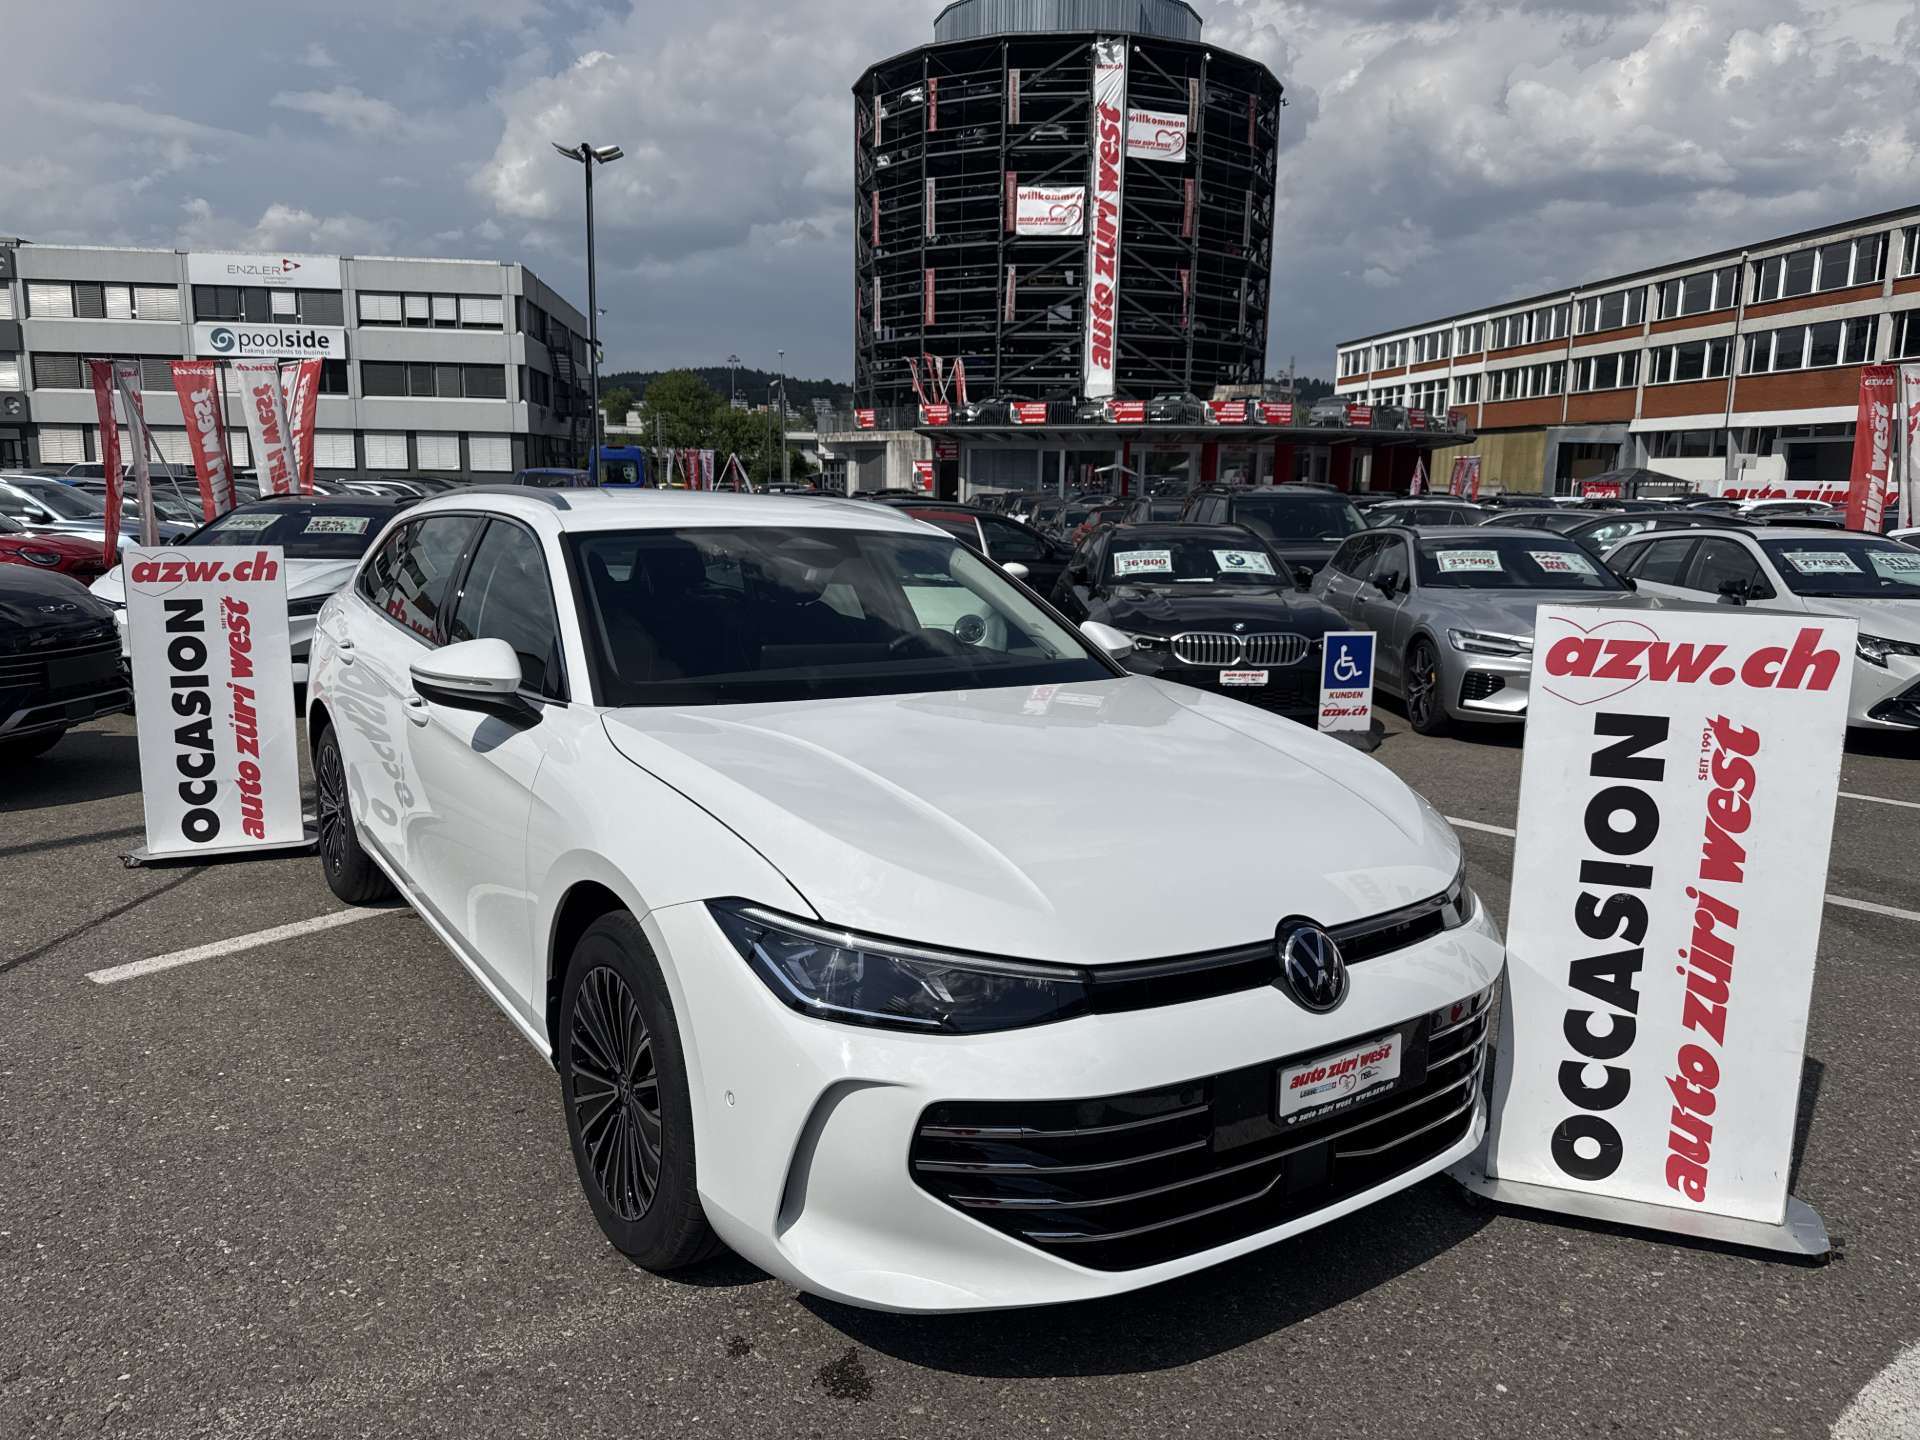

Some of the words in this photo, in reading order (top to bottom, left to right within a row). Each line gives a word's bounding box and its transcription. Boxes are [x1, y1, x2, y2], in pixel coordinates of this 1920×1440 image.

[1099, 101, 1121, 192] west
[1128, 113, 1186, 127] willkommen
[227, 264, 281, 276] ENZLER
[1092, 196, 1117, 281] züri
[238, 329, 330, 353] poolside
[244, 347, 265, 355] taking
[265, 347, 293, 356] students
[1091, 282, 1114, 370] auto
[1871, 401, 1890, 470] west
[131, 551, 278, 583] azw.ch
[1124, 558, 1167, 567] 36'800
[220, 595, 255, 679] west
[1544, 628, 1842, 691] azw.ch
[163, 598, 221, 843] OCCASION
[225, 682, 262, 758] züri
[1321, 704, 1369, 718] azw.ch
[1328, 691, 1364, 699] KUNDEN
[1697, 755, 1709, 782] SEIT
[1700, 727, 1713, 753] 1991
[232, 761, 266, 840] auto
[1698, 714, 1762, 884] west
[1550, 712, 1670, 1182] OCCASION
[1674, 885, 1741, 1046] züri
[1289, 1066, 1327, 1090] auto
[1326, 1053, 1360, 1079] züri
[1359, 1042, 1393, 1068] west
[1664, 1043, 1721, 1203] auto
